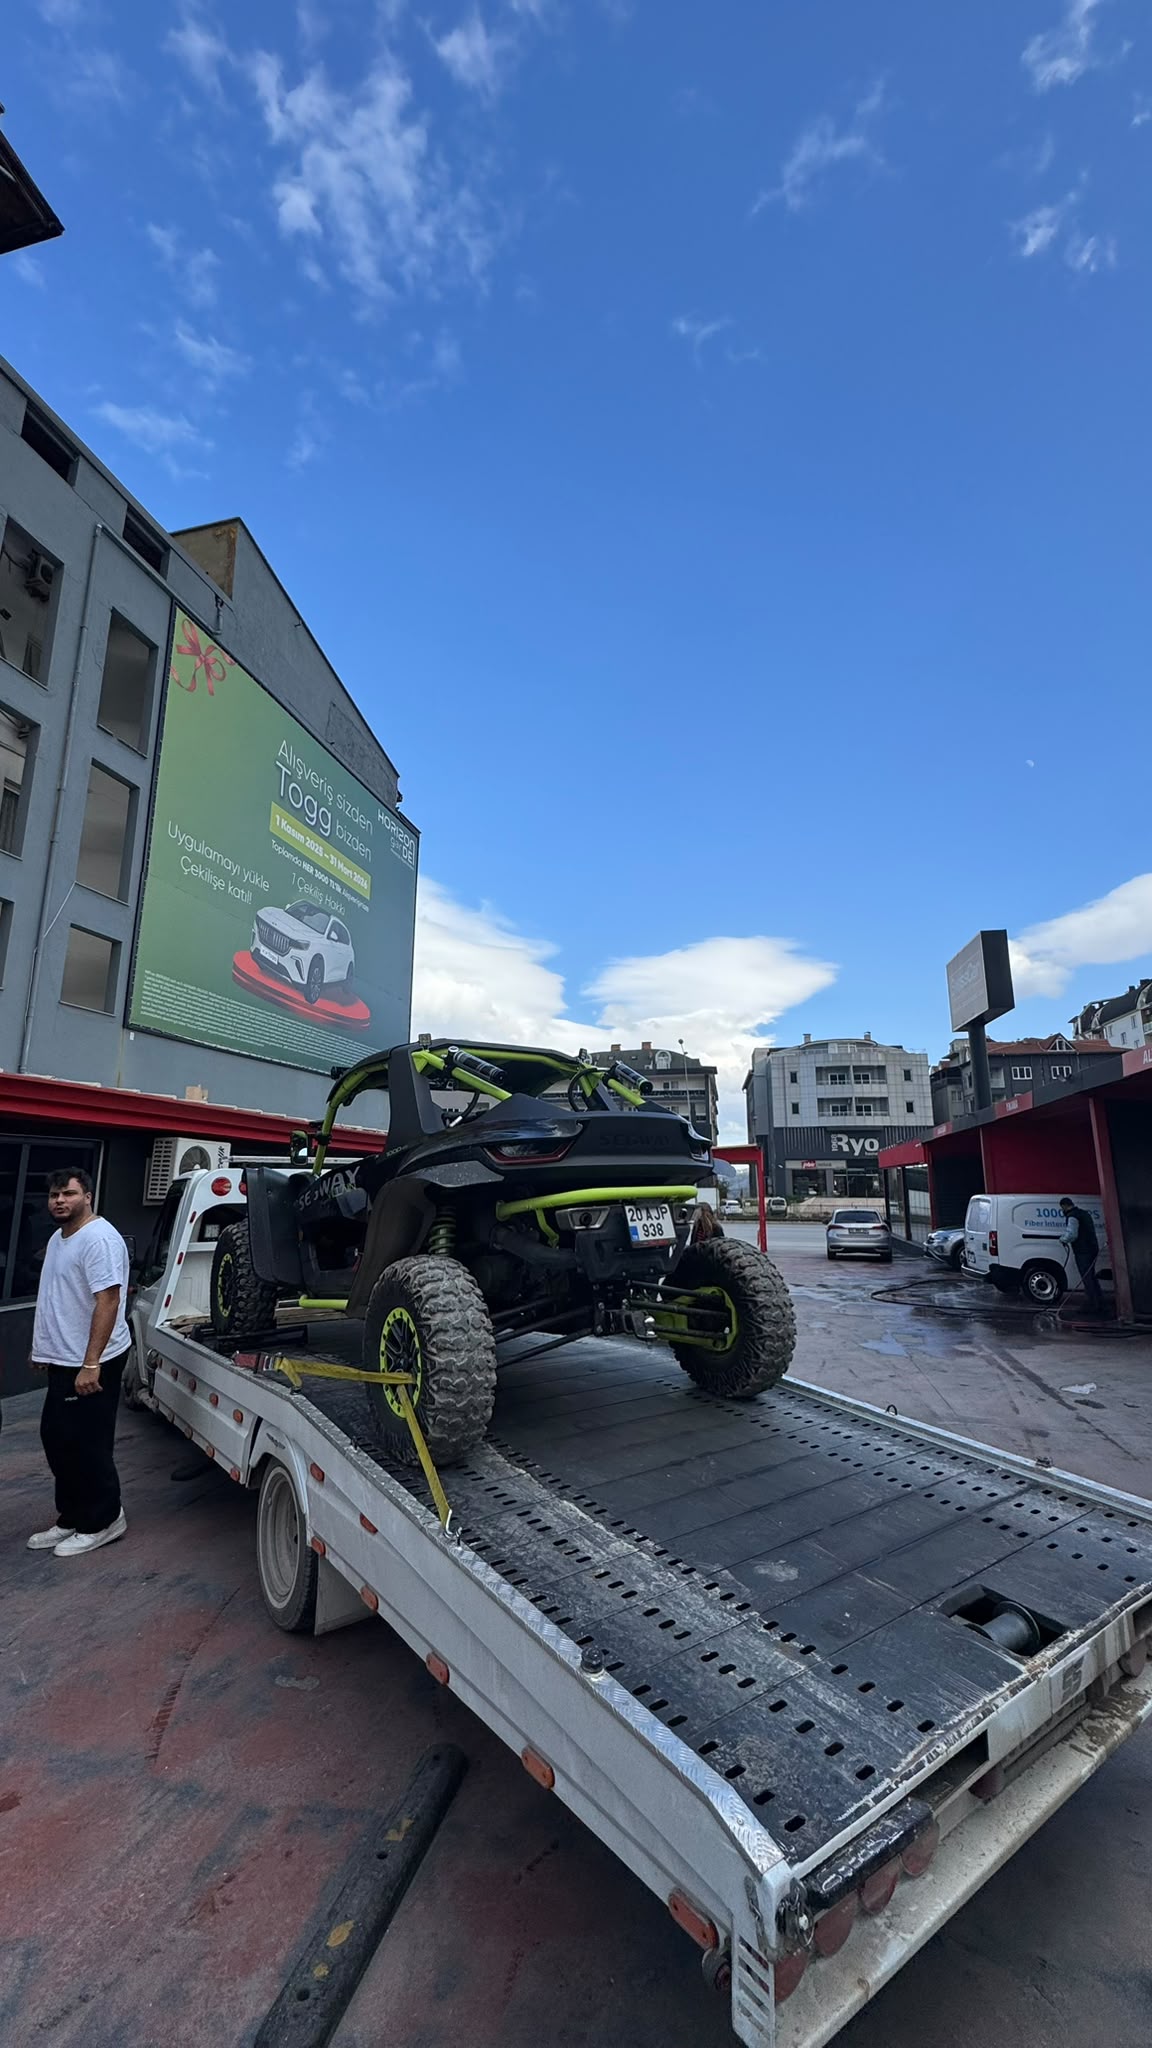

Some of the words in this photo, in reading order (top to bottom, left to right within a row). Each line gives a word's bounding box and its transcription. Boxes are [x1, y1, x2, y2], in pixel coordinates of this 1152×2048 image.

[278, 739, 334, 806] Alışveriş
[336, 794, 373, 836] sizden
[275, 760, 332, 838] Togg
[335, 820, 372, 862] bizden
[281, 818, 305, 844] Kasım
[305, 836, 324, 857] 2025
[168, 820, 241, 876] Uygulamayı
[243, 868, 270, 892] yükle
[302, 860, 314, 876] HER
[180, 855, 225, 890] Çekilişe
[297, 876, 324, 905] Çekiliş
[838, 1133, 879, 1156] Ryo
[628, 1207, 643, 1222] 20
[646, 1206, 668, 1221] AJP
[1025, 1219, 1043, 1228] Fiber
[642, 1223, 664, 1237] 938
